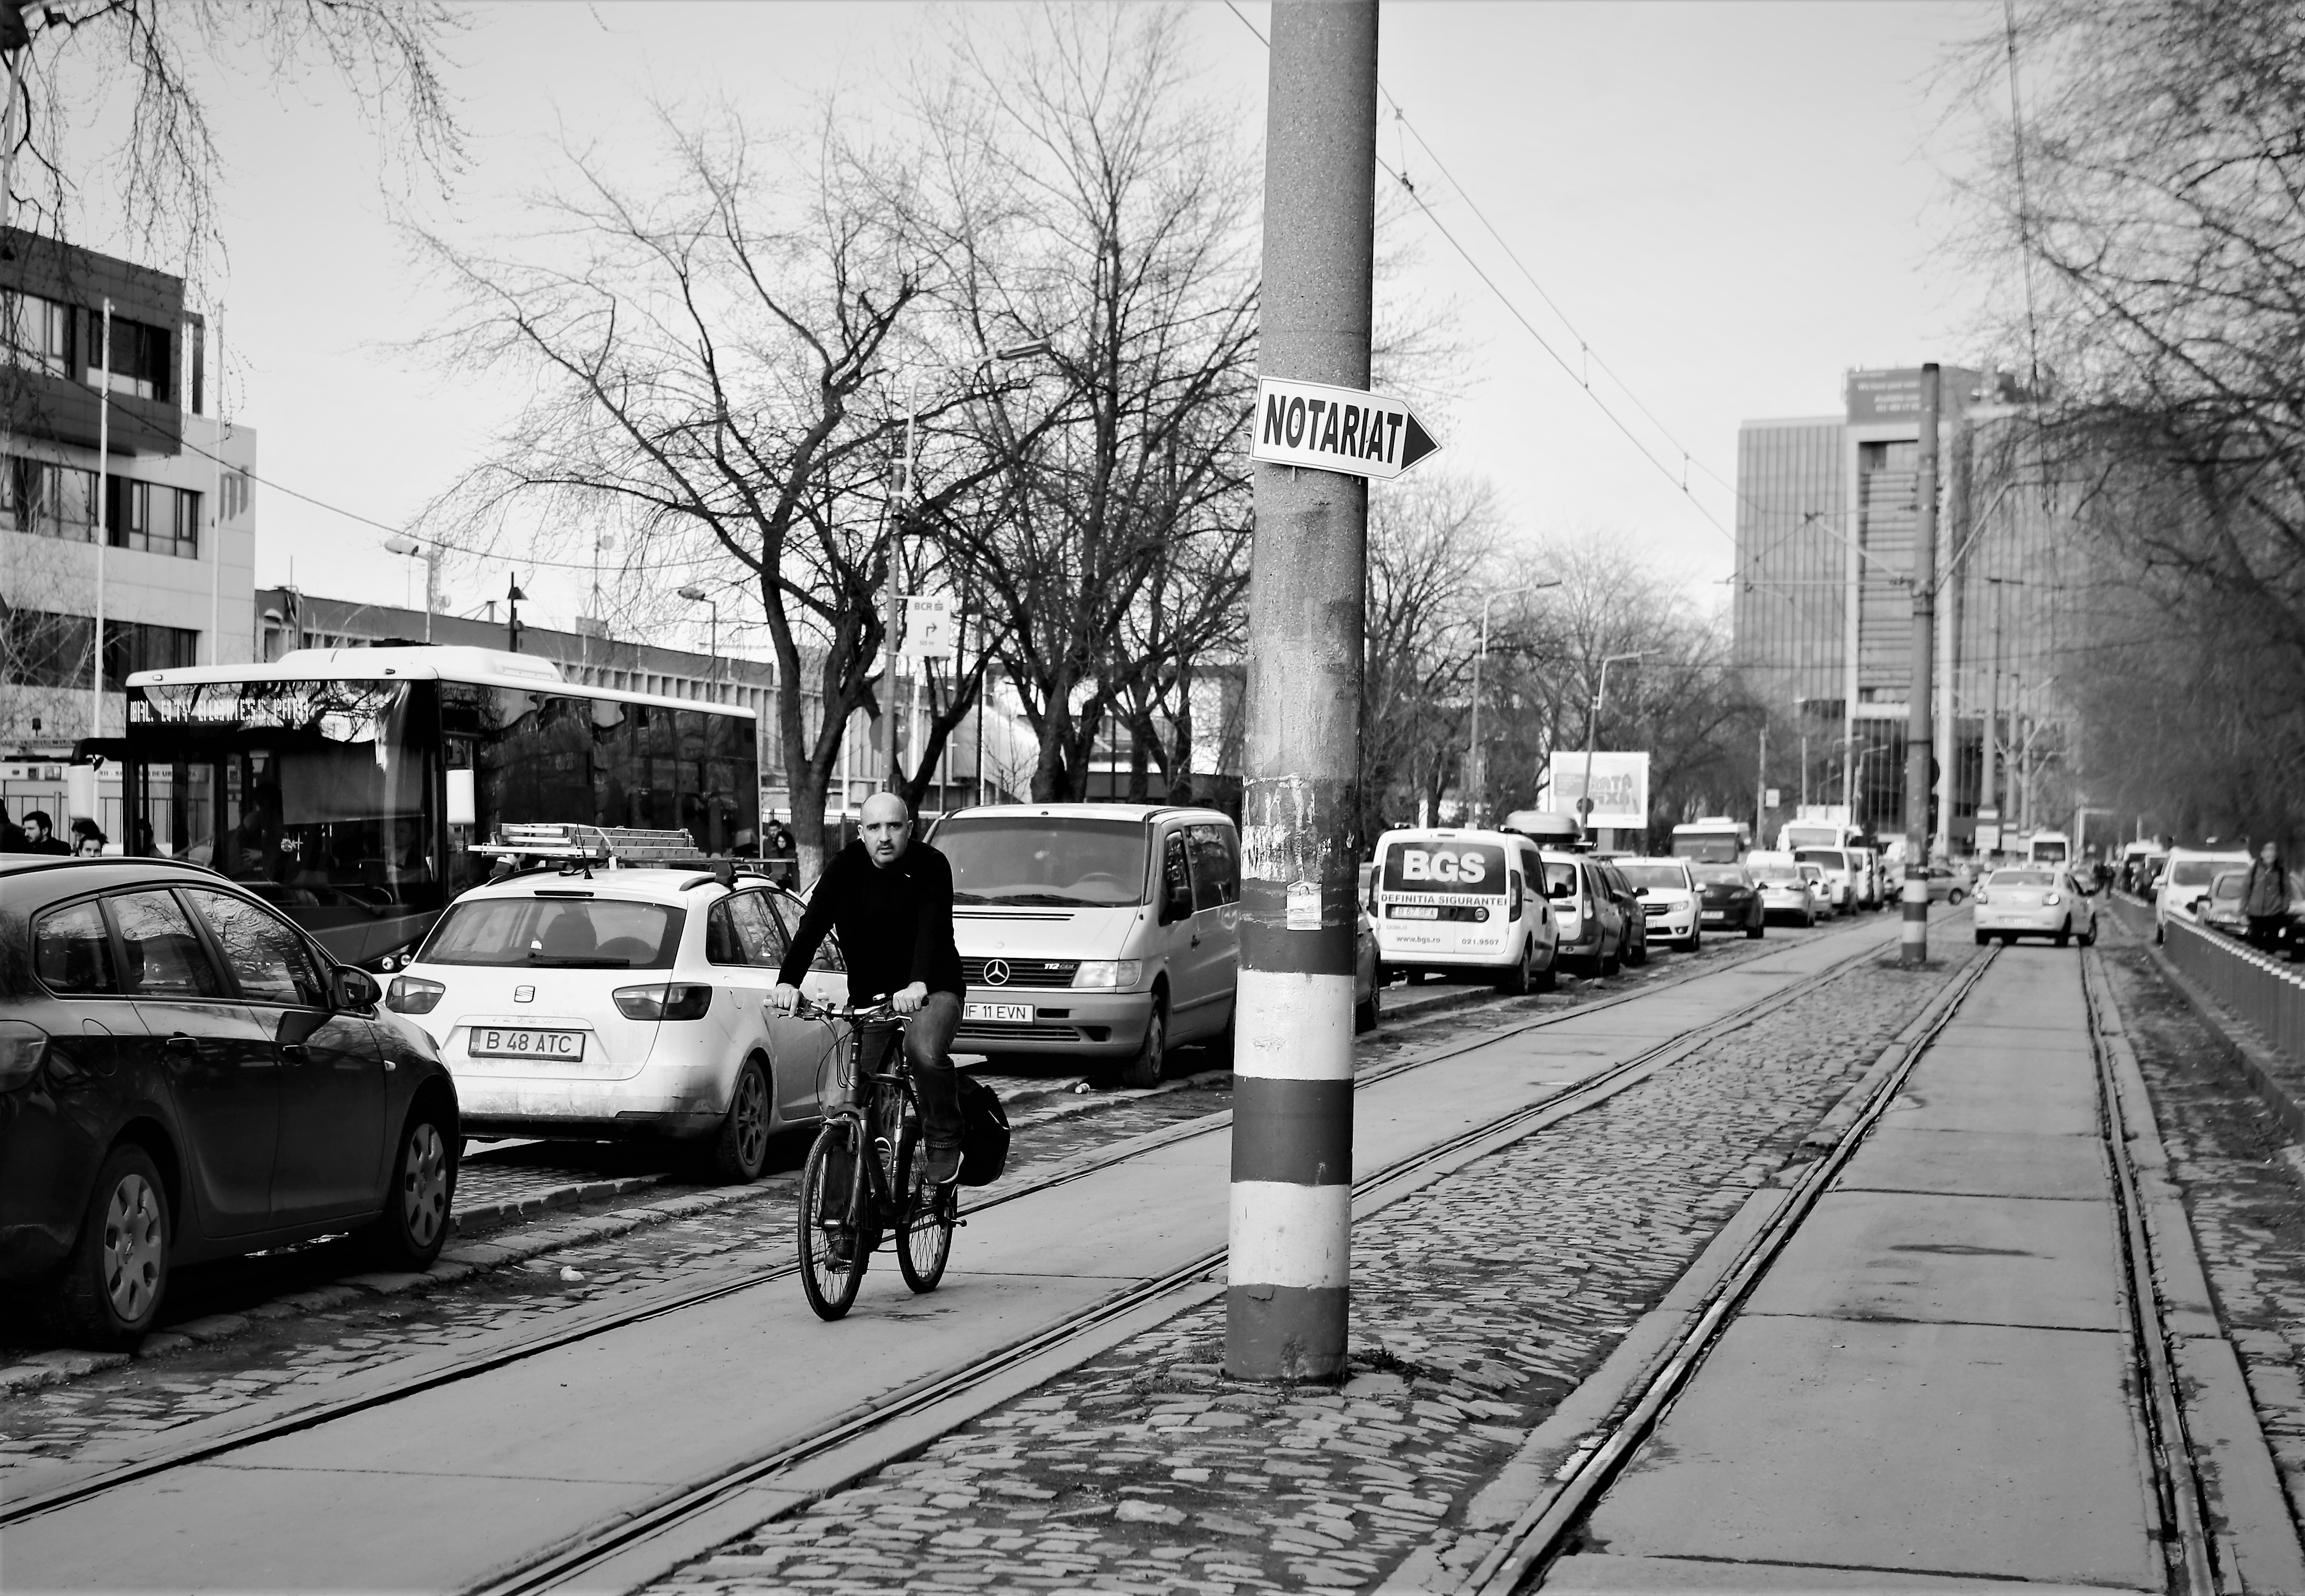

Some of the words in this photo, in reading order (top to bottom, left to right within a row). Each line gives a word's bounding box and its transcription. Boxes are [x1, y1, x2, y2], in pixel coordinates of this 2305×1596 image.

[1263, 394, 1403, 464] NOTARIAT
[1402, 850, 1486, 884] BGS
[1382, 894, 1435, 904] DEFINITIA
[1438, 896, 1507, 906] SIGURANTEI
[1396, 935, 1441, 944] www.bgs.ro
[966, 1005, 978, 1018] IF
[983, 1005, 992, 1018] 11
[996, 1006, 1026, 1020] EVN
[486, 1031, 500, 1049] B
[507, 1033, 529, 1051] 48
[535, 1034, 572, 1053] ATC
